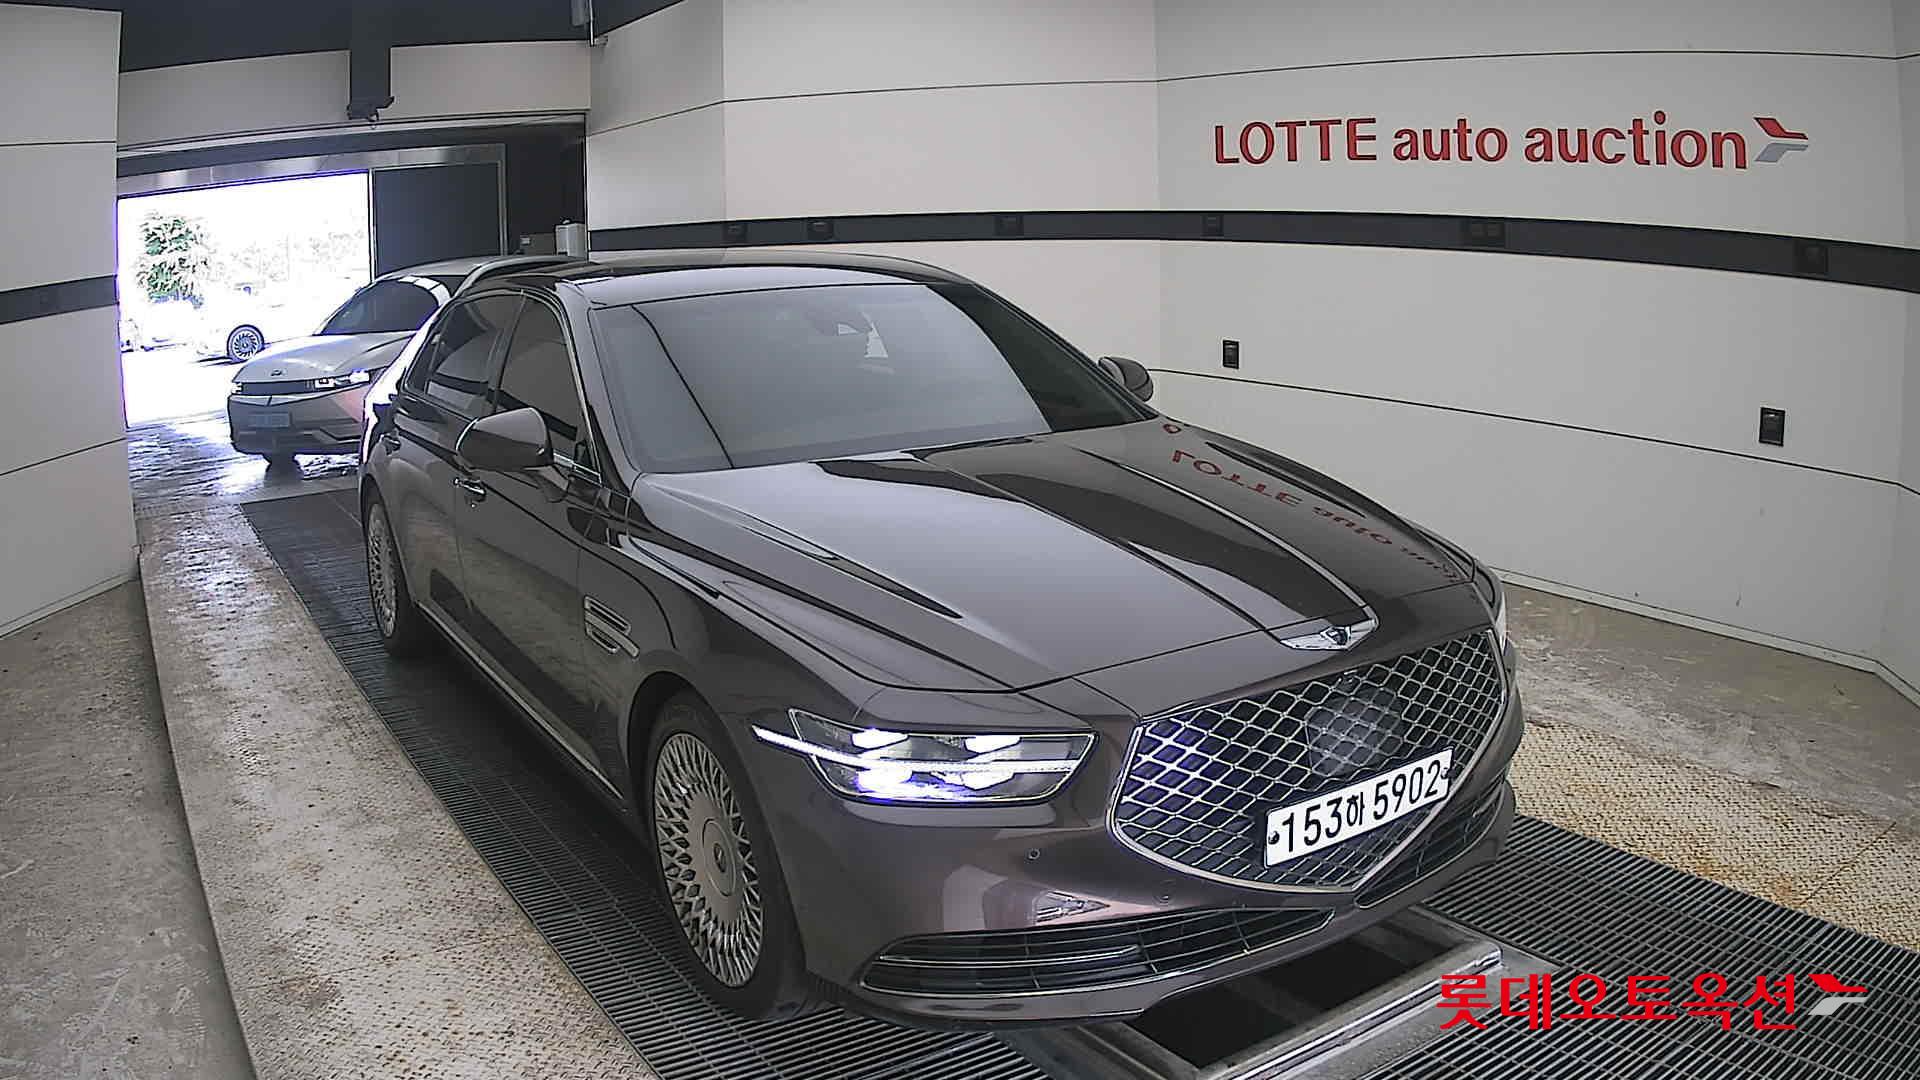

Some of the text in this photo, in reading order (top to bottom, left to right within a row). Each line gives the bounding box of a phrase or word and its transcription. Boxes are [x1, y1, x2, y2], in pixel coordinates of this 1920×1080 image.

[1214, 110, 1747, 169] LOTTE auto auction
[1282, 759, 1441, 852] 153하 5902
